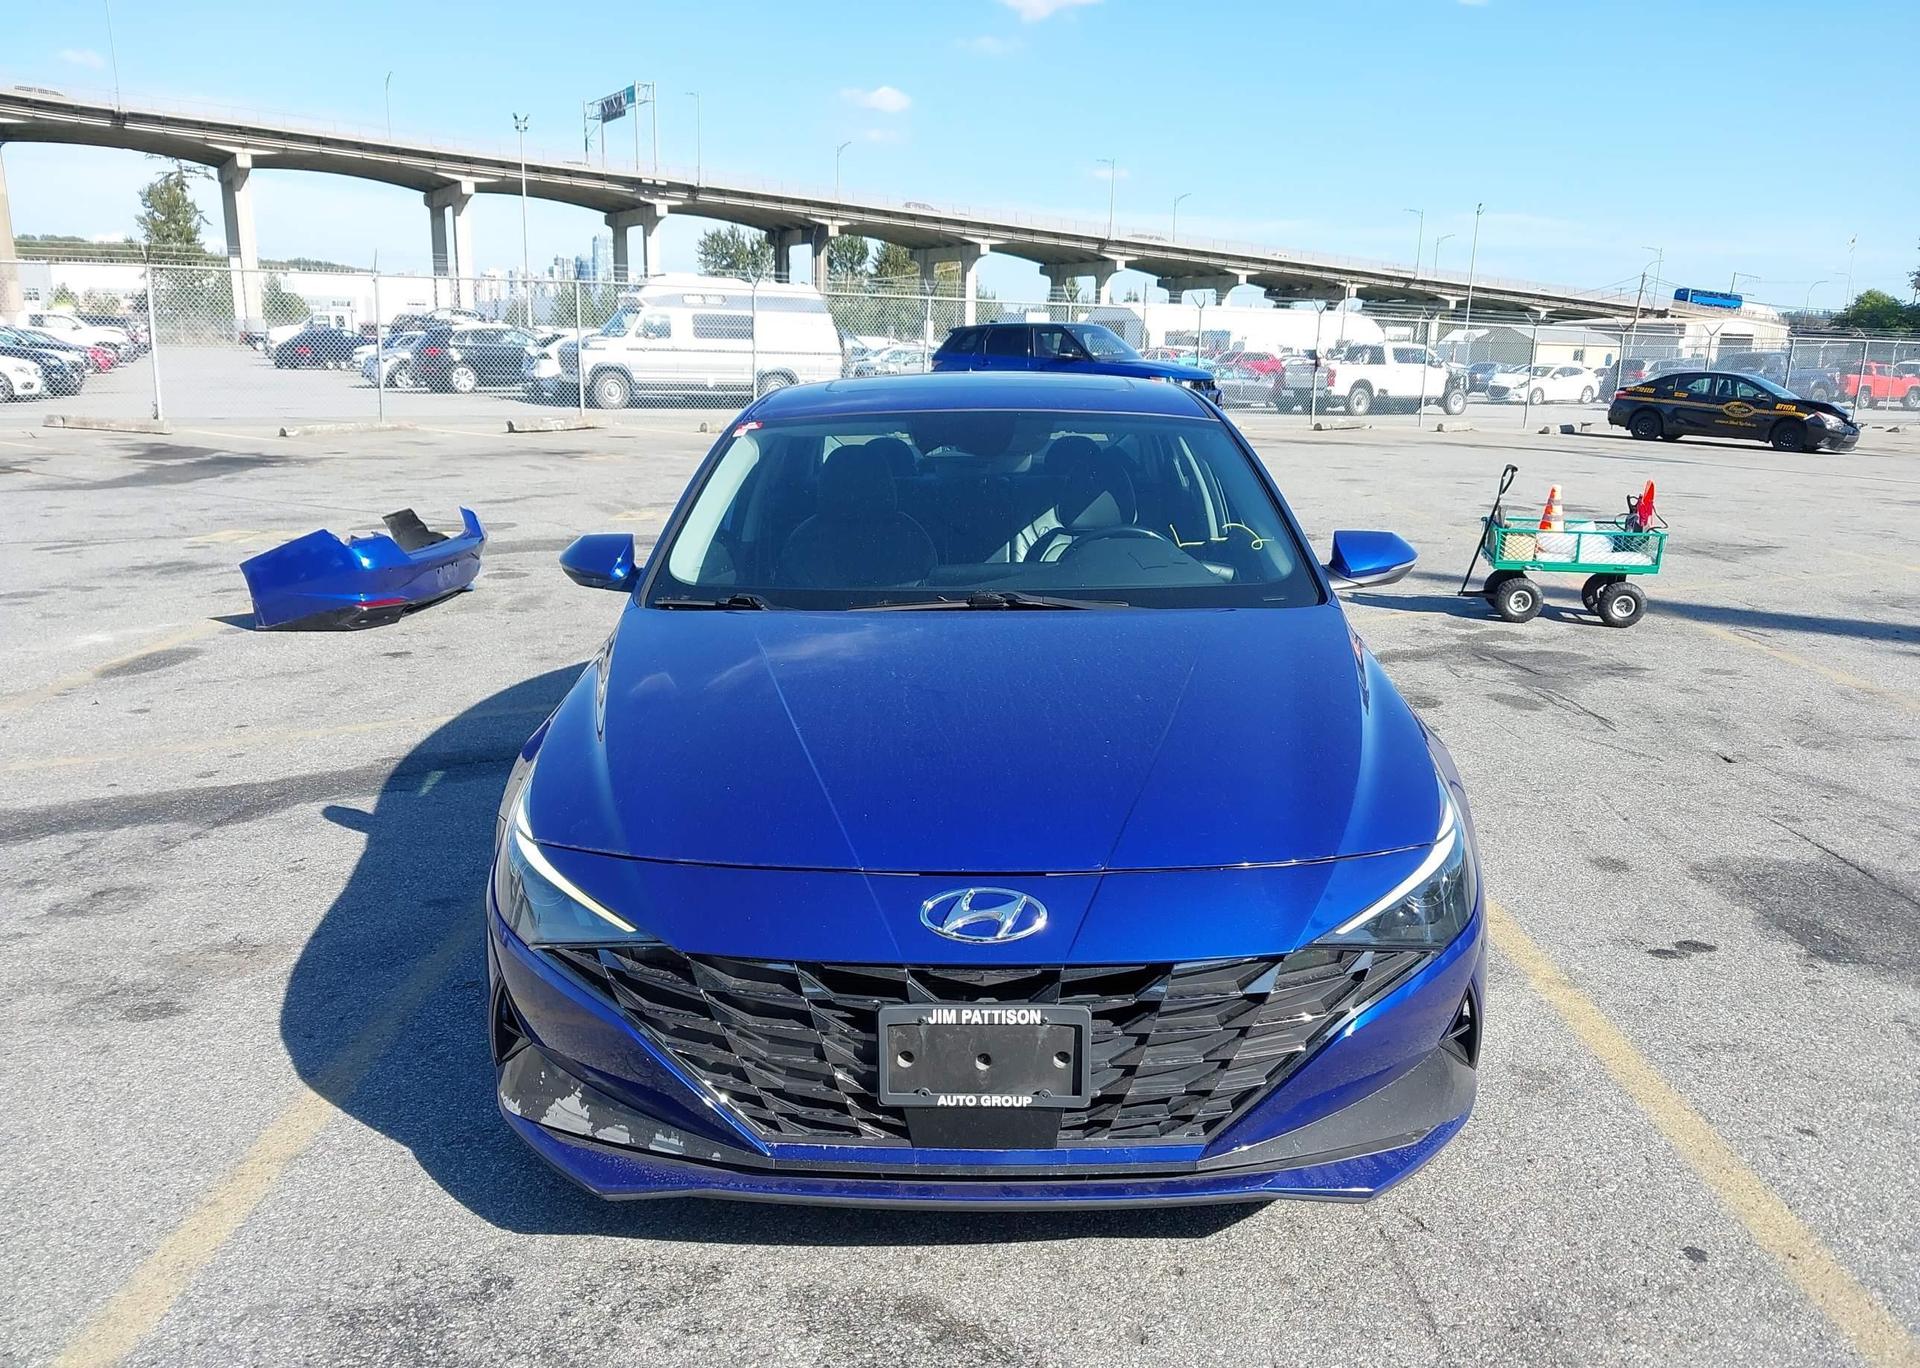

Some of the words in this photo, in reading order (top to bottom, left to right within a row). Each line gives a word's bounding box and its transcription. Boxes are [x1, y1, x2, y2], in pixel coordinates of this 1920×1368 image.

[927, 1009, 957, 1024] JIM
[961, 1009, 1042, 1025] PATTISON
[937, 1095, 976, 1107] AUTO
[981, 1096, 1032, 1107] GROUP
